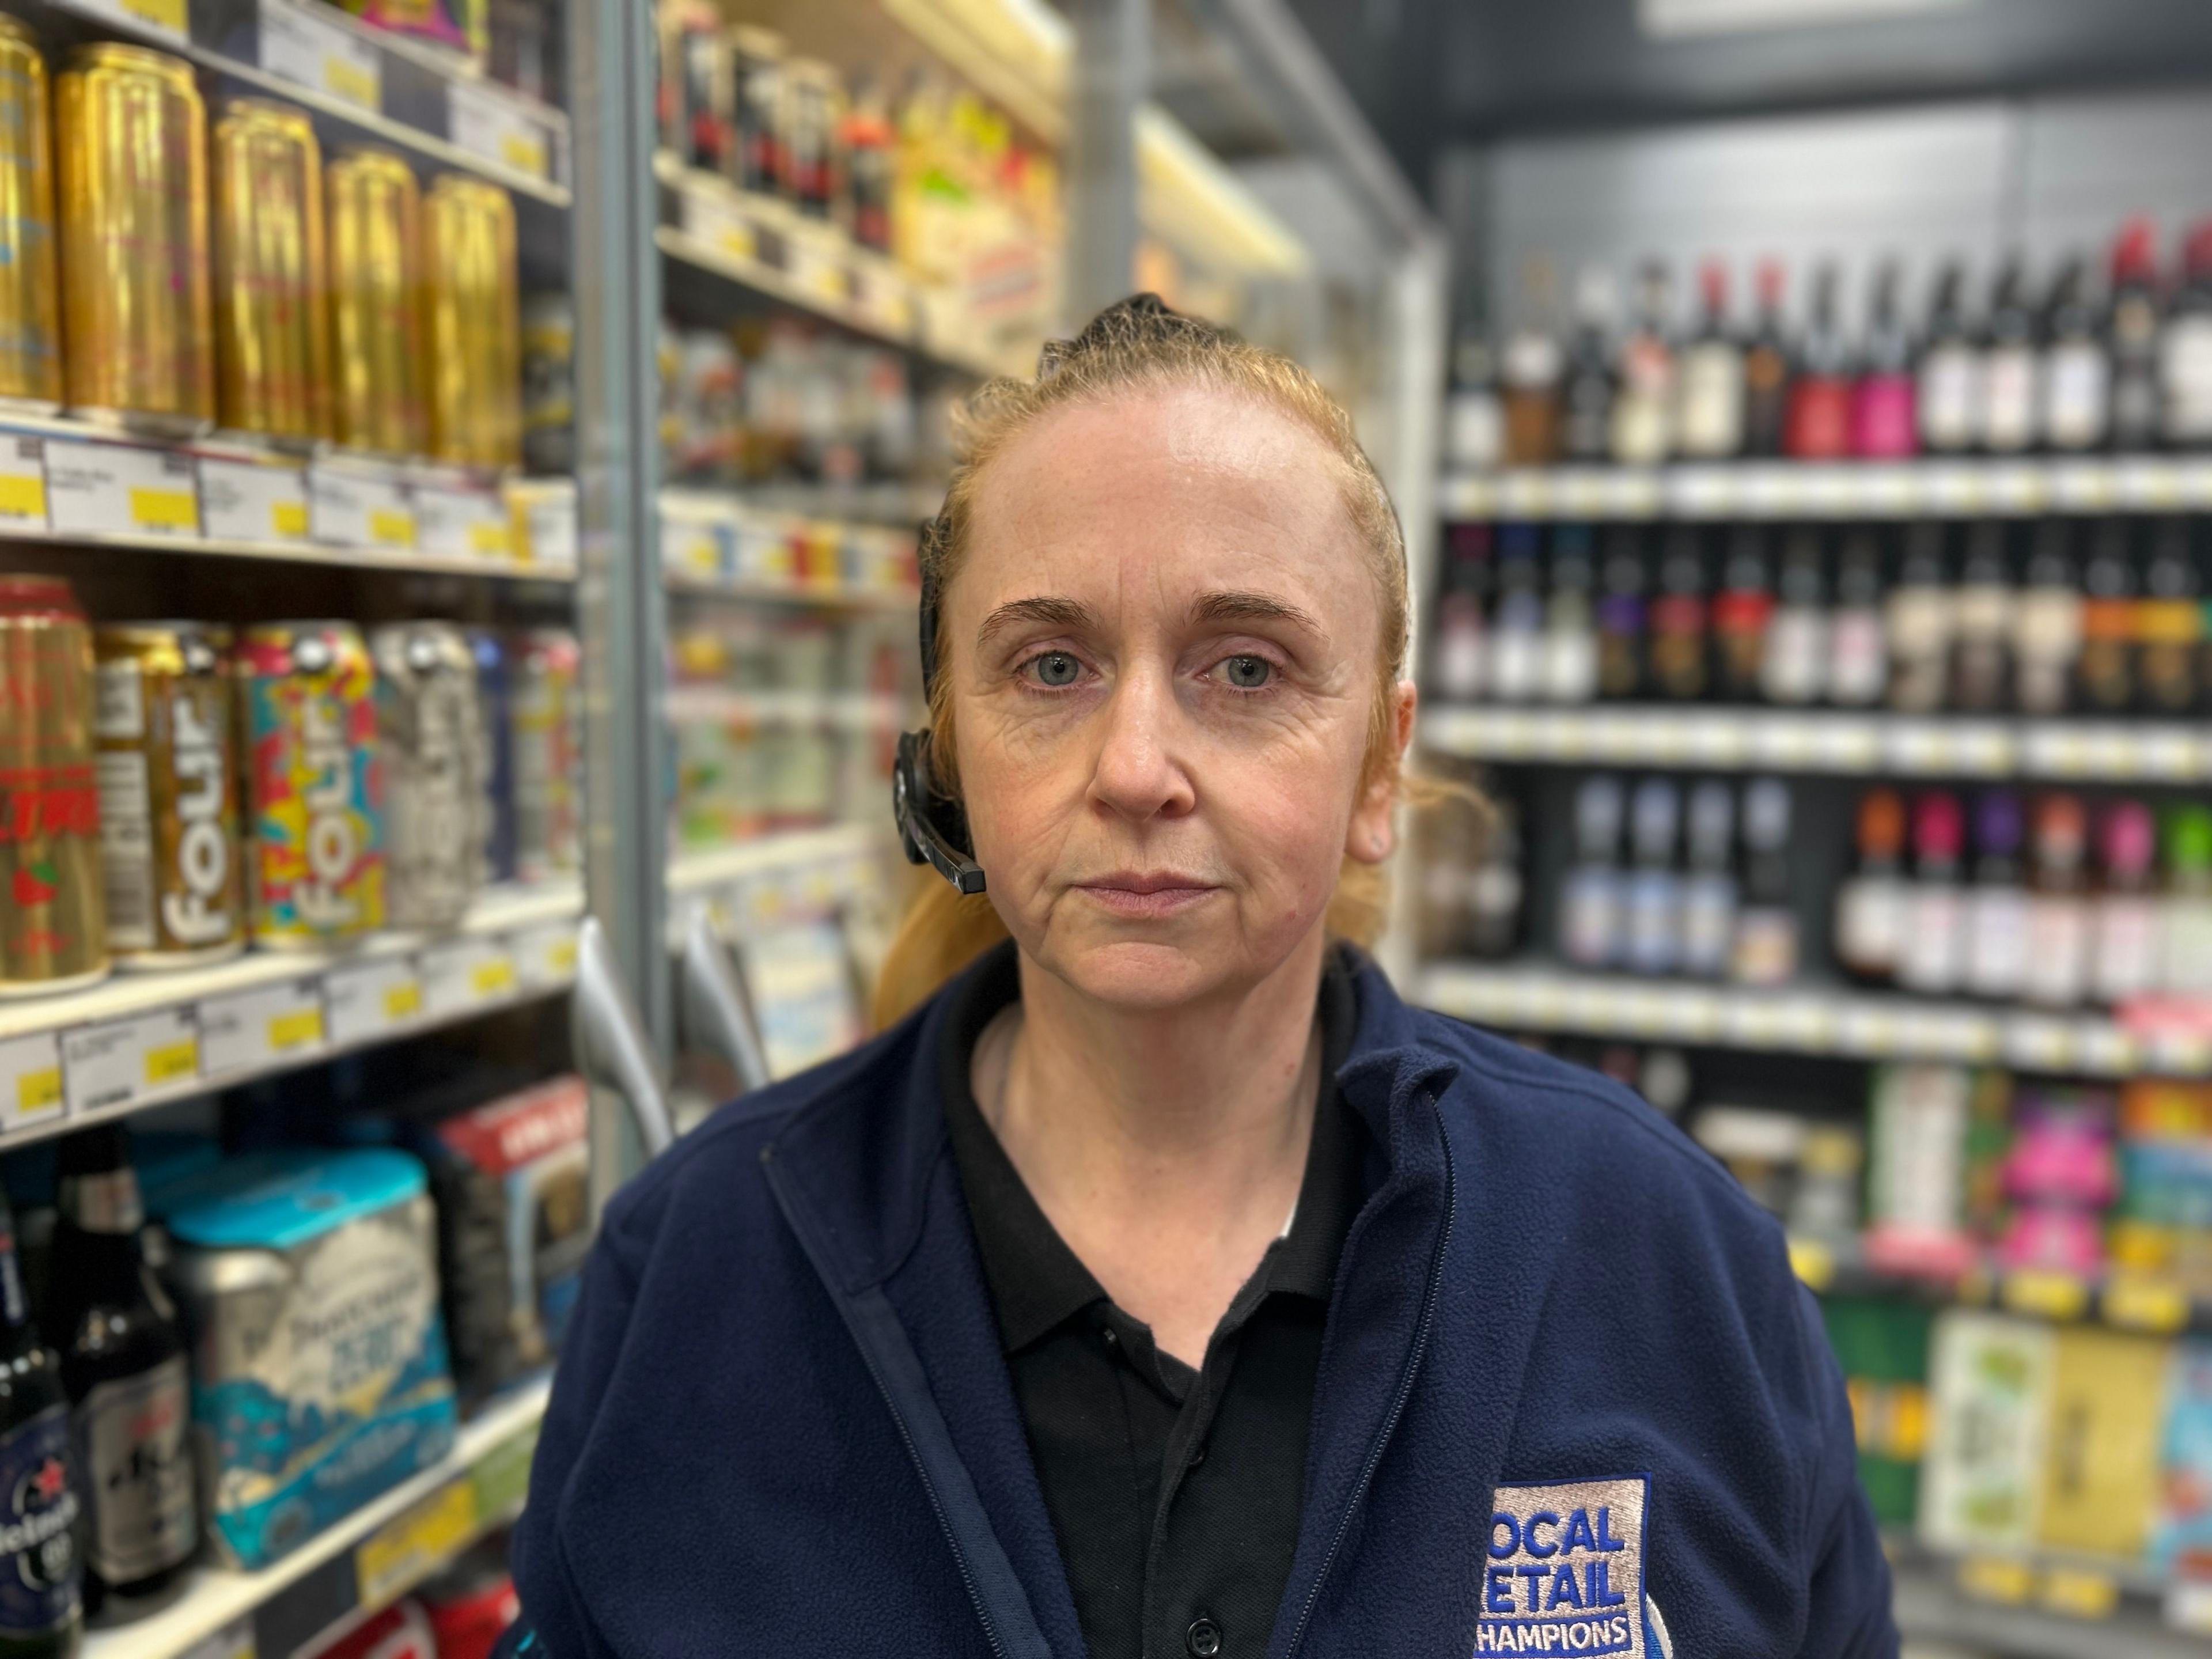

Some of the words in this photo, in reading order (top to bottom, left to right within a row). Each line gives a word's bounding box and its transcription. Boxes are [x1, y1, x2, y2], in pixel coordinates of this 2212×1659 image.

[163, 698, 230, 944] four
[294, 694, 358, 925] four
[1488, 1506, 1625, 1559] OCAL
[1487, 1561, 1626, 1613] ETAIL
[1474, 1616, 1627, 1652] HAMPIONS
